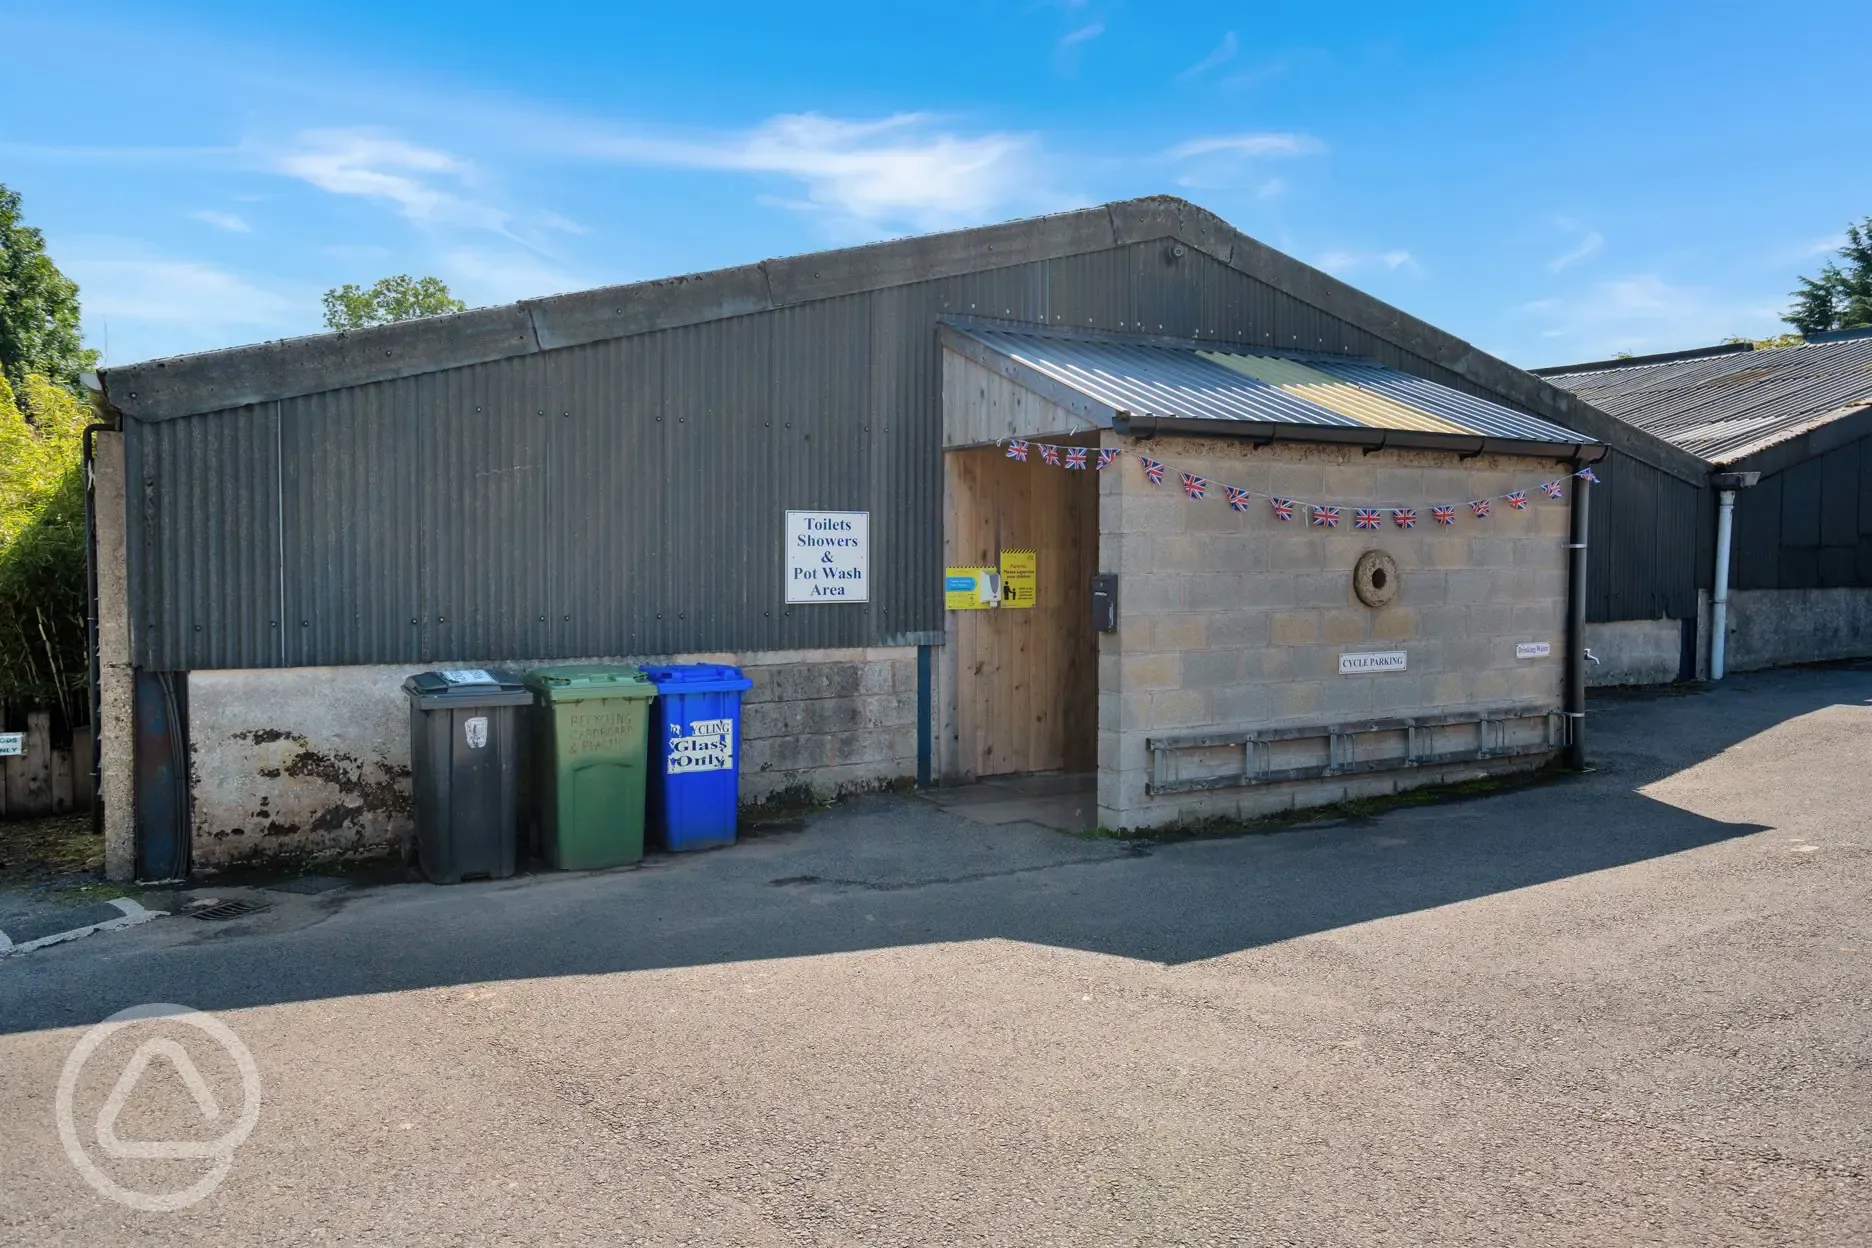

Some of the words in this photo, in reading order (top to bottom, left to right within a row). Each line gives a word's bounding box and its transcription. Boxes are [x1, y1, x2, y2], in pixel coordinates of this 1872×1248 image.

[804, 518, 852, 531] Toilets
[797, 534, 858, 547] Showers
[821, 550, 834, 563] &
[794, 567, 817, 580] Pot
[822, 567, 862, 580] Wash
[810, 584, 845, 596] Area
[1342, 658, 1369, 668] CYCLE
[1370, 656, 1403, 667] PARKING
[674, 740, 727, 752] Glass
[676, 754, 725, 768] Only
